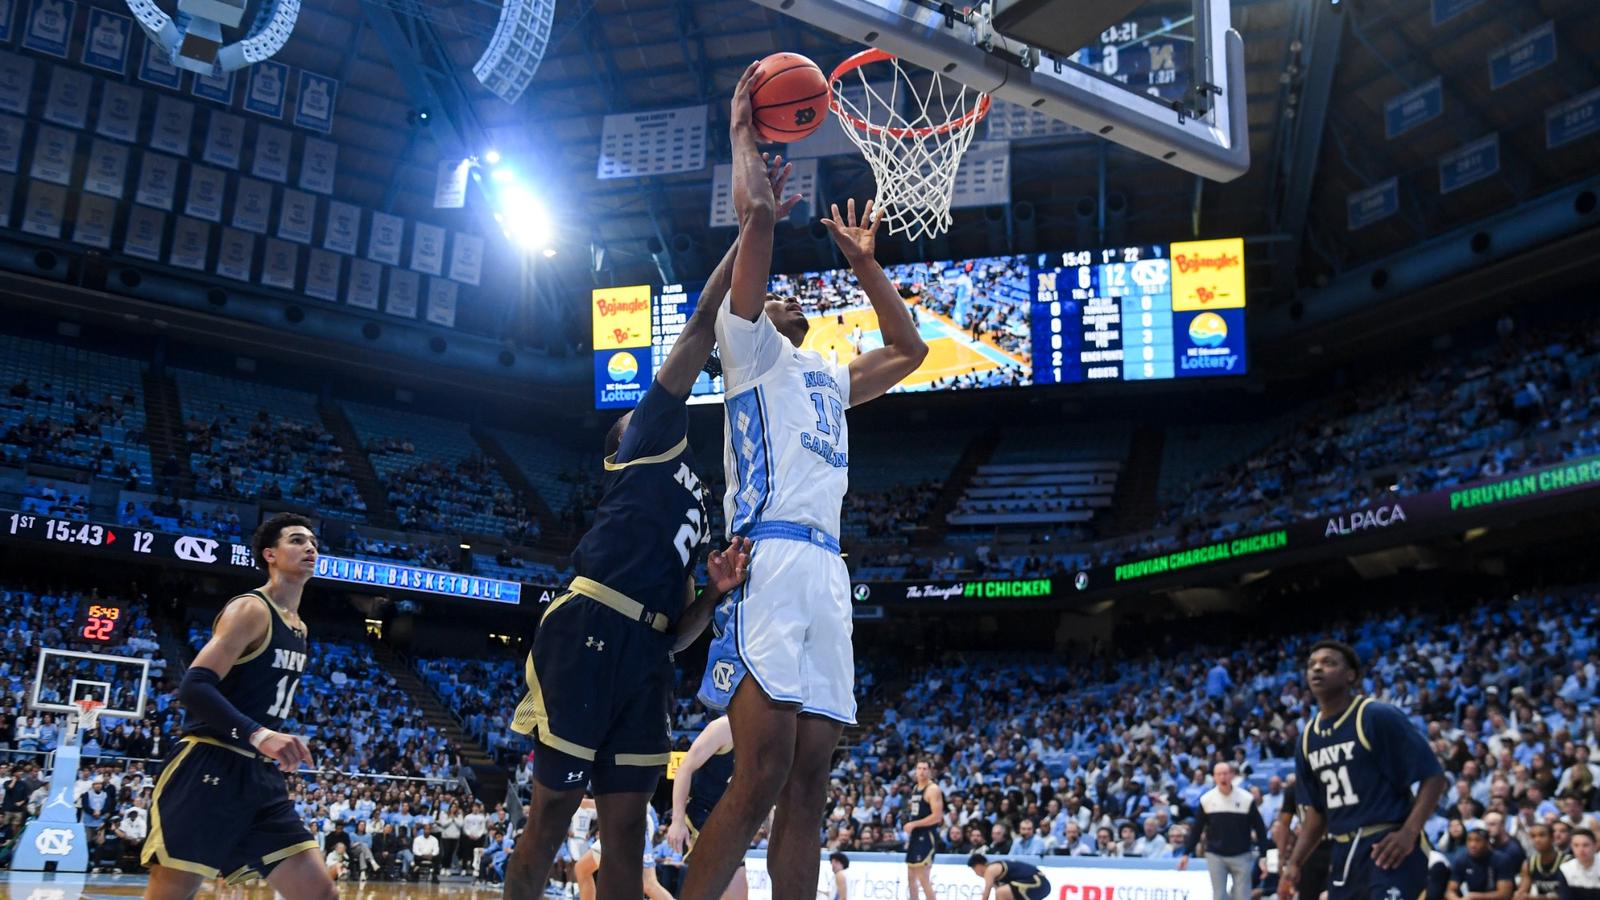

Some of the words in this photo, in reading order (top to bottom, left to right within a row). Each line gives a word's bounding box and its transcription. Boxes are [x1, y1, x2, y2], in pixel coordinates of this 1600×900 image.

[1062, 251, 1091, 267] 15:43
[1175, 253, 1239, 273] Bojangles
[1037, 272, 1057, 292] N
[1078, 266, 1091, 289] 6
[1105, 263, 1126, 287] 12
[597, 298, 649, 317] Bojangles
[1052, 351, 1063, 367] 2
[1181, 355, 1238, 370] Lottery
[1053, 367, 1062, 383] 1
[601, 390, 646, 403] Lottery
[810, 392, 842, 446] 15
[1450, 475, 1537, 511] PERUVIAN
[1539, 461, 1600, 491] CHARC
[1324, 504, 1408, 538] ALPACA
[9, 513, 36, 535] 1ST
[46, 519, 104, 546] 15:43
[133, 531, 155, 553] 12
[231, 543, 251, 556] TOL:
[1115, 556, 1168, 581] PERUVIAN
[1170, 542, 1230, 569] CHARCOAL
[1231, 530, 1287, 555] CHICKEN
[318, 557, 376, 582] OLINA
[388, 572, 502, 599] BASKETBALL
[906, 586, 923, 599] The
[922, 583, 963, 600] Triangle's
[963, 583, 982, 598] #1
[985, 580, 1052, 597] CHICKEN
[89, 604, 120, 620] 15:43
[83, 617, 114, 641] 22
[1308, 740, 1356, 771] NAVY
[1320, 765, 1359, 809] 21
[864, 871, 901, 900] best
